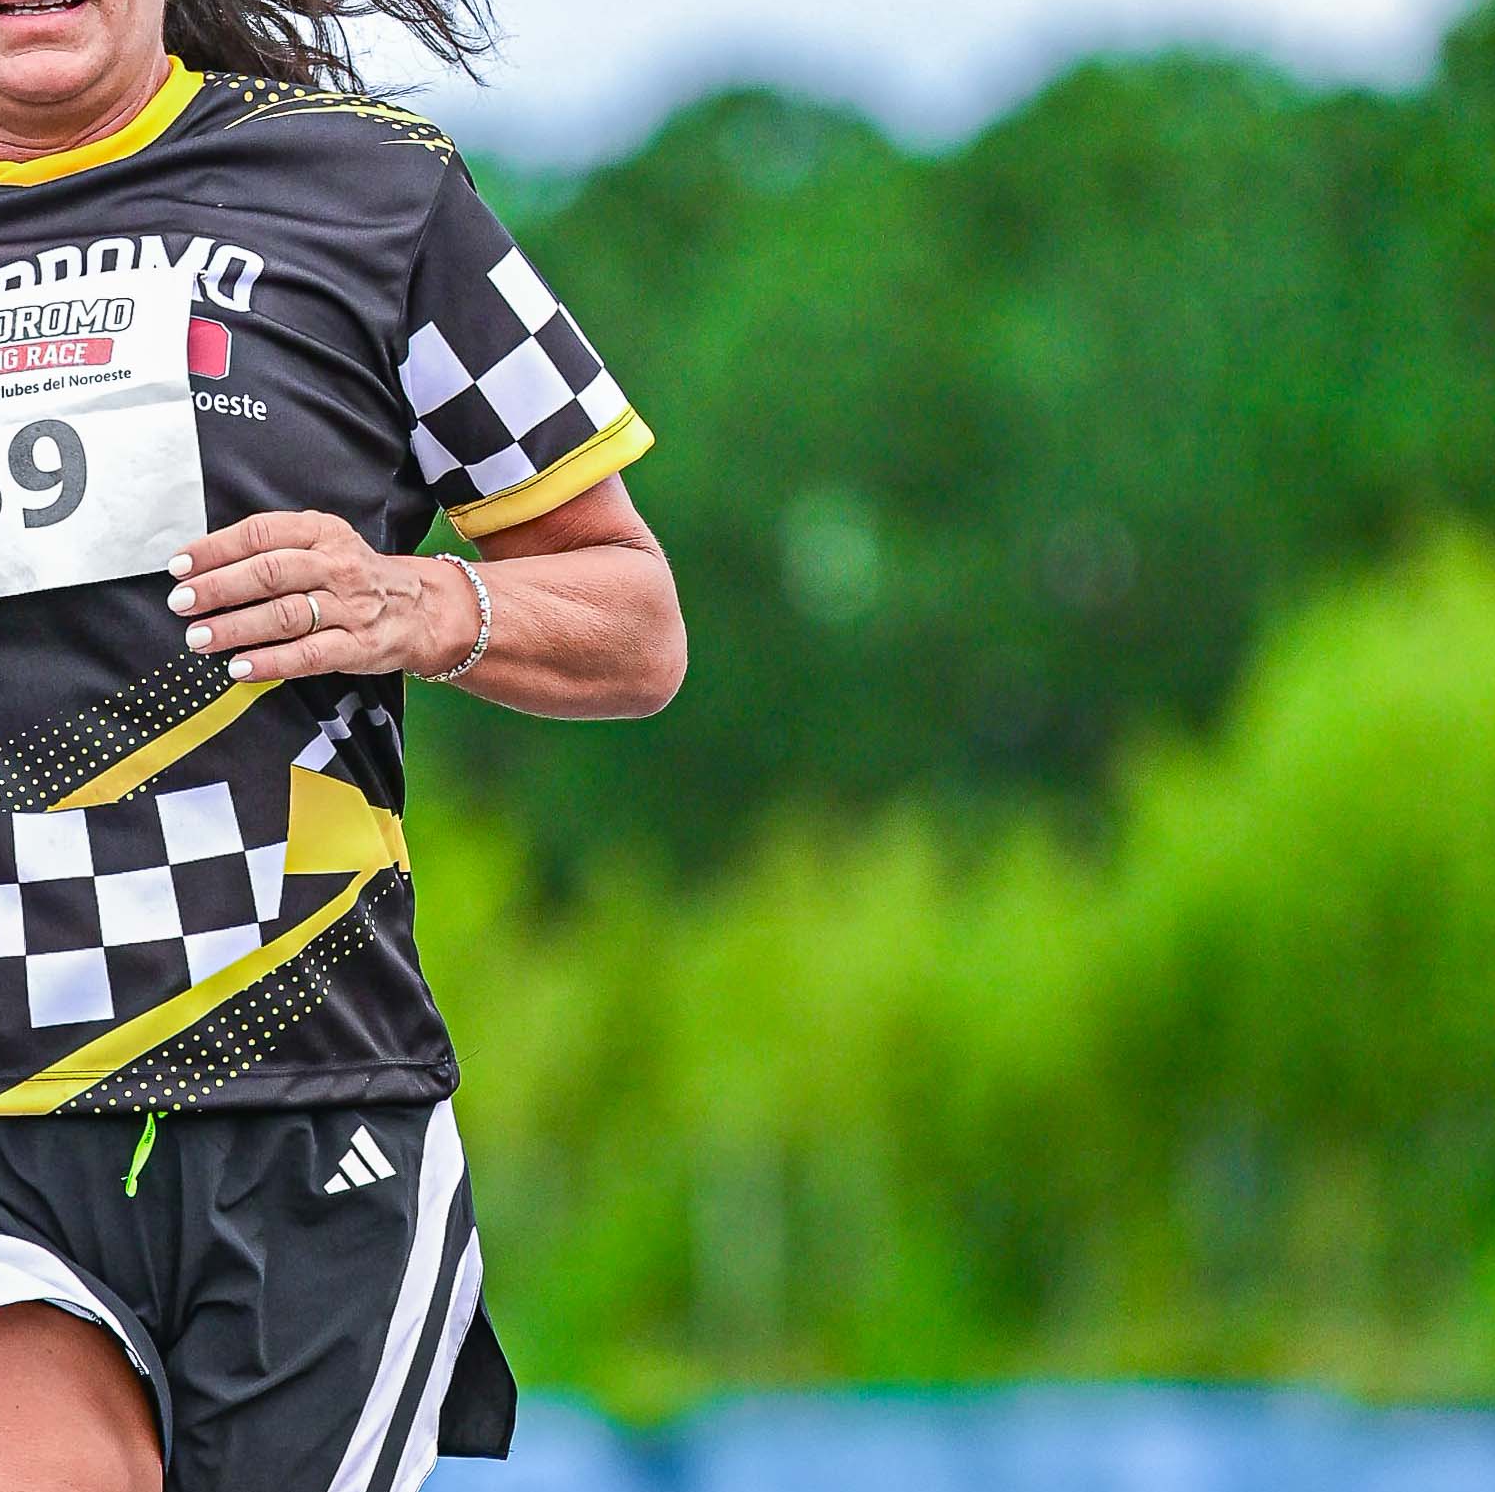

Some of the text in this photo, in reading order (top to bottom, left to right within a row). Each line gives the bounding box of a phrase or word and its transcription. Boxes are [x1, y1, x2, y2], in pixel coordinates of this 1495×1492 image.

[26, 342, 89, 367] RACE
[43, 376, 65, 391] del
[69, 368, 132, 388] Noroeste
[191, 391, 268, 422] oeste
